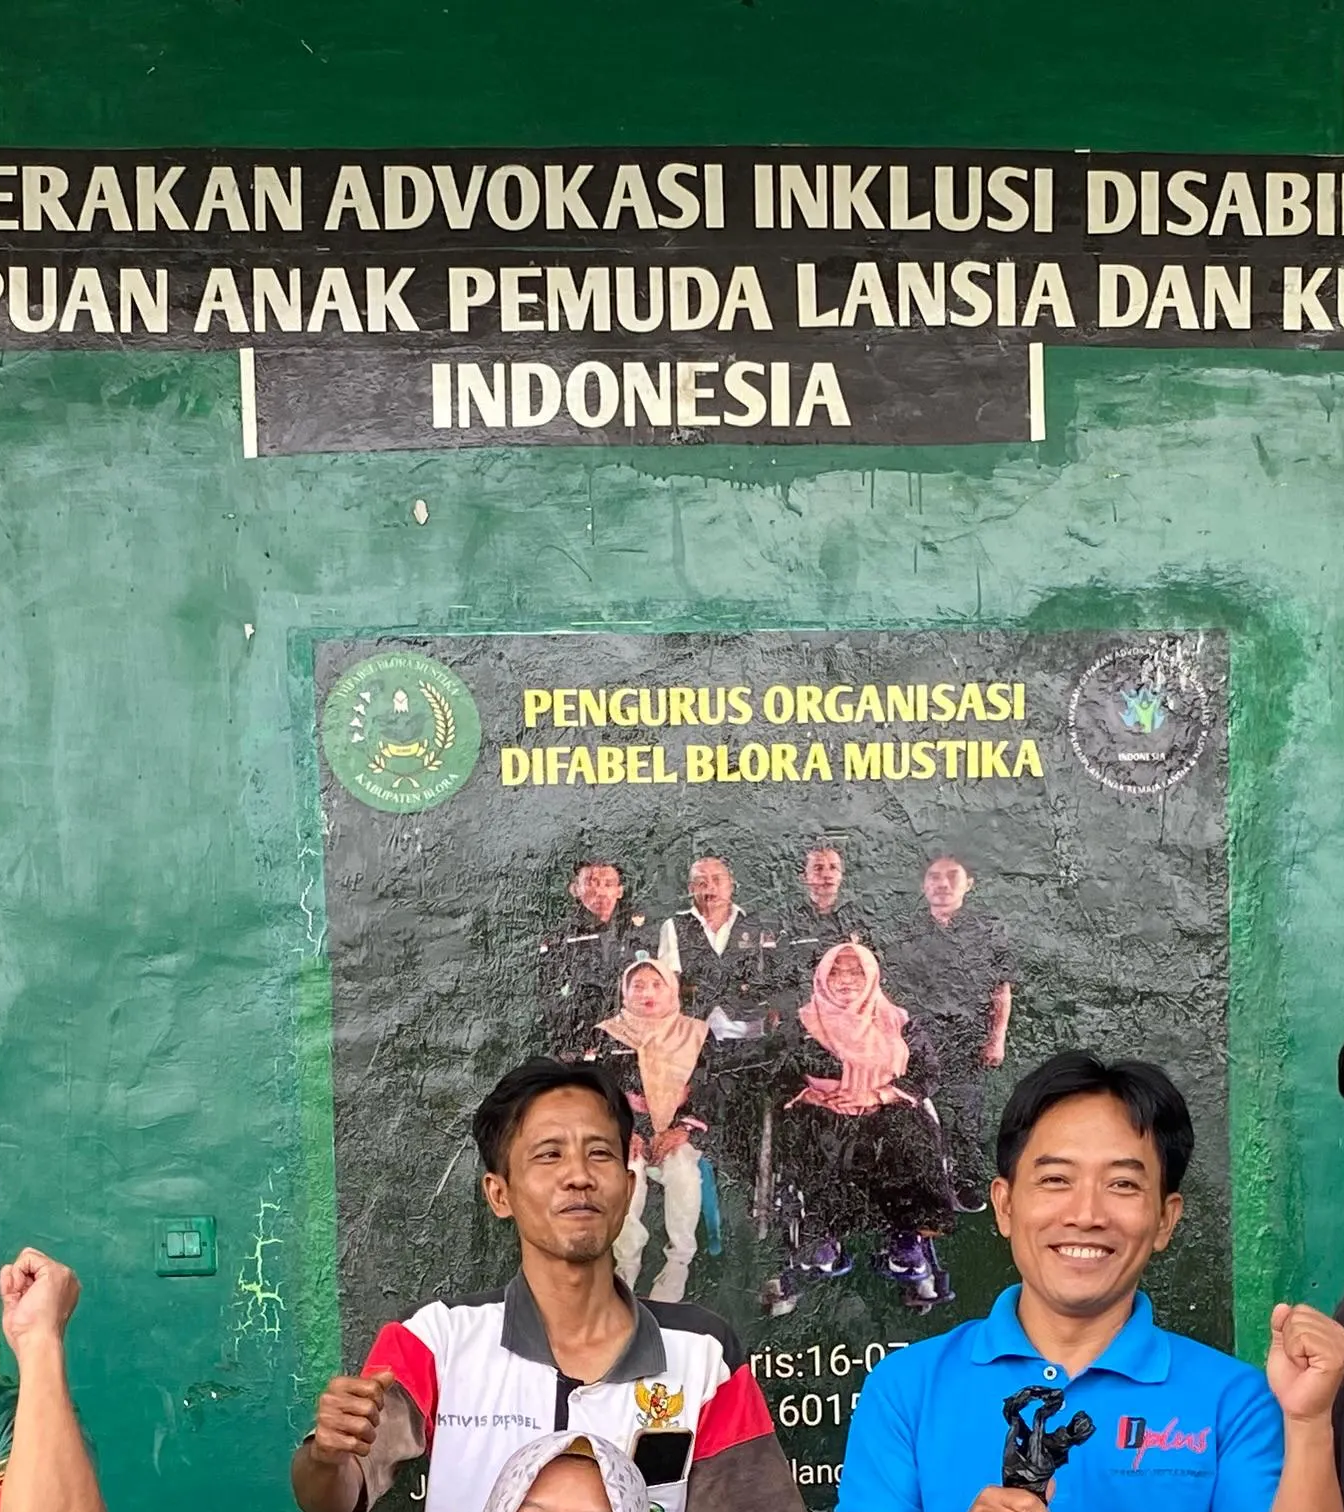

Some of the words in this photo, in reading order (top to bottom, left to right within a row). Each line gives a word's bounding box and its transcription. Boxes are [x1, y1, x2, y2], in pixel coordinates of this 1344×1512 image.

[324, 163, 725, 231] ADVOKASI
[755, 164, 1053, 233] INKLUSI
[193, 267, 420, 333] ANAK
[448, 266, 773, 333] PEMUDA
[797, 261, 1075, 328] LANSIA
[1098, 264, 1251, 330] DAN
[431, 360, 852, 428] INDONESIA
[523, 685, 752, 727] PENGURUS
[763, 681, 1026, 724] ORGANISASI
[500, 745, 677, 786] DIFABEL
[686, 741, 828, 783] BLORA
[844, 738, 1044, 781] MUSTIKA
